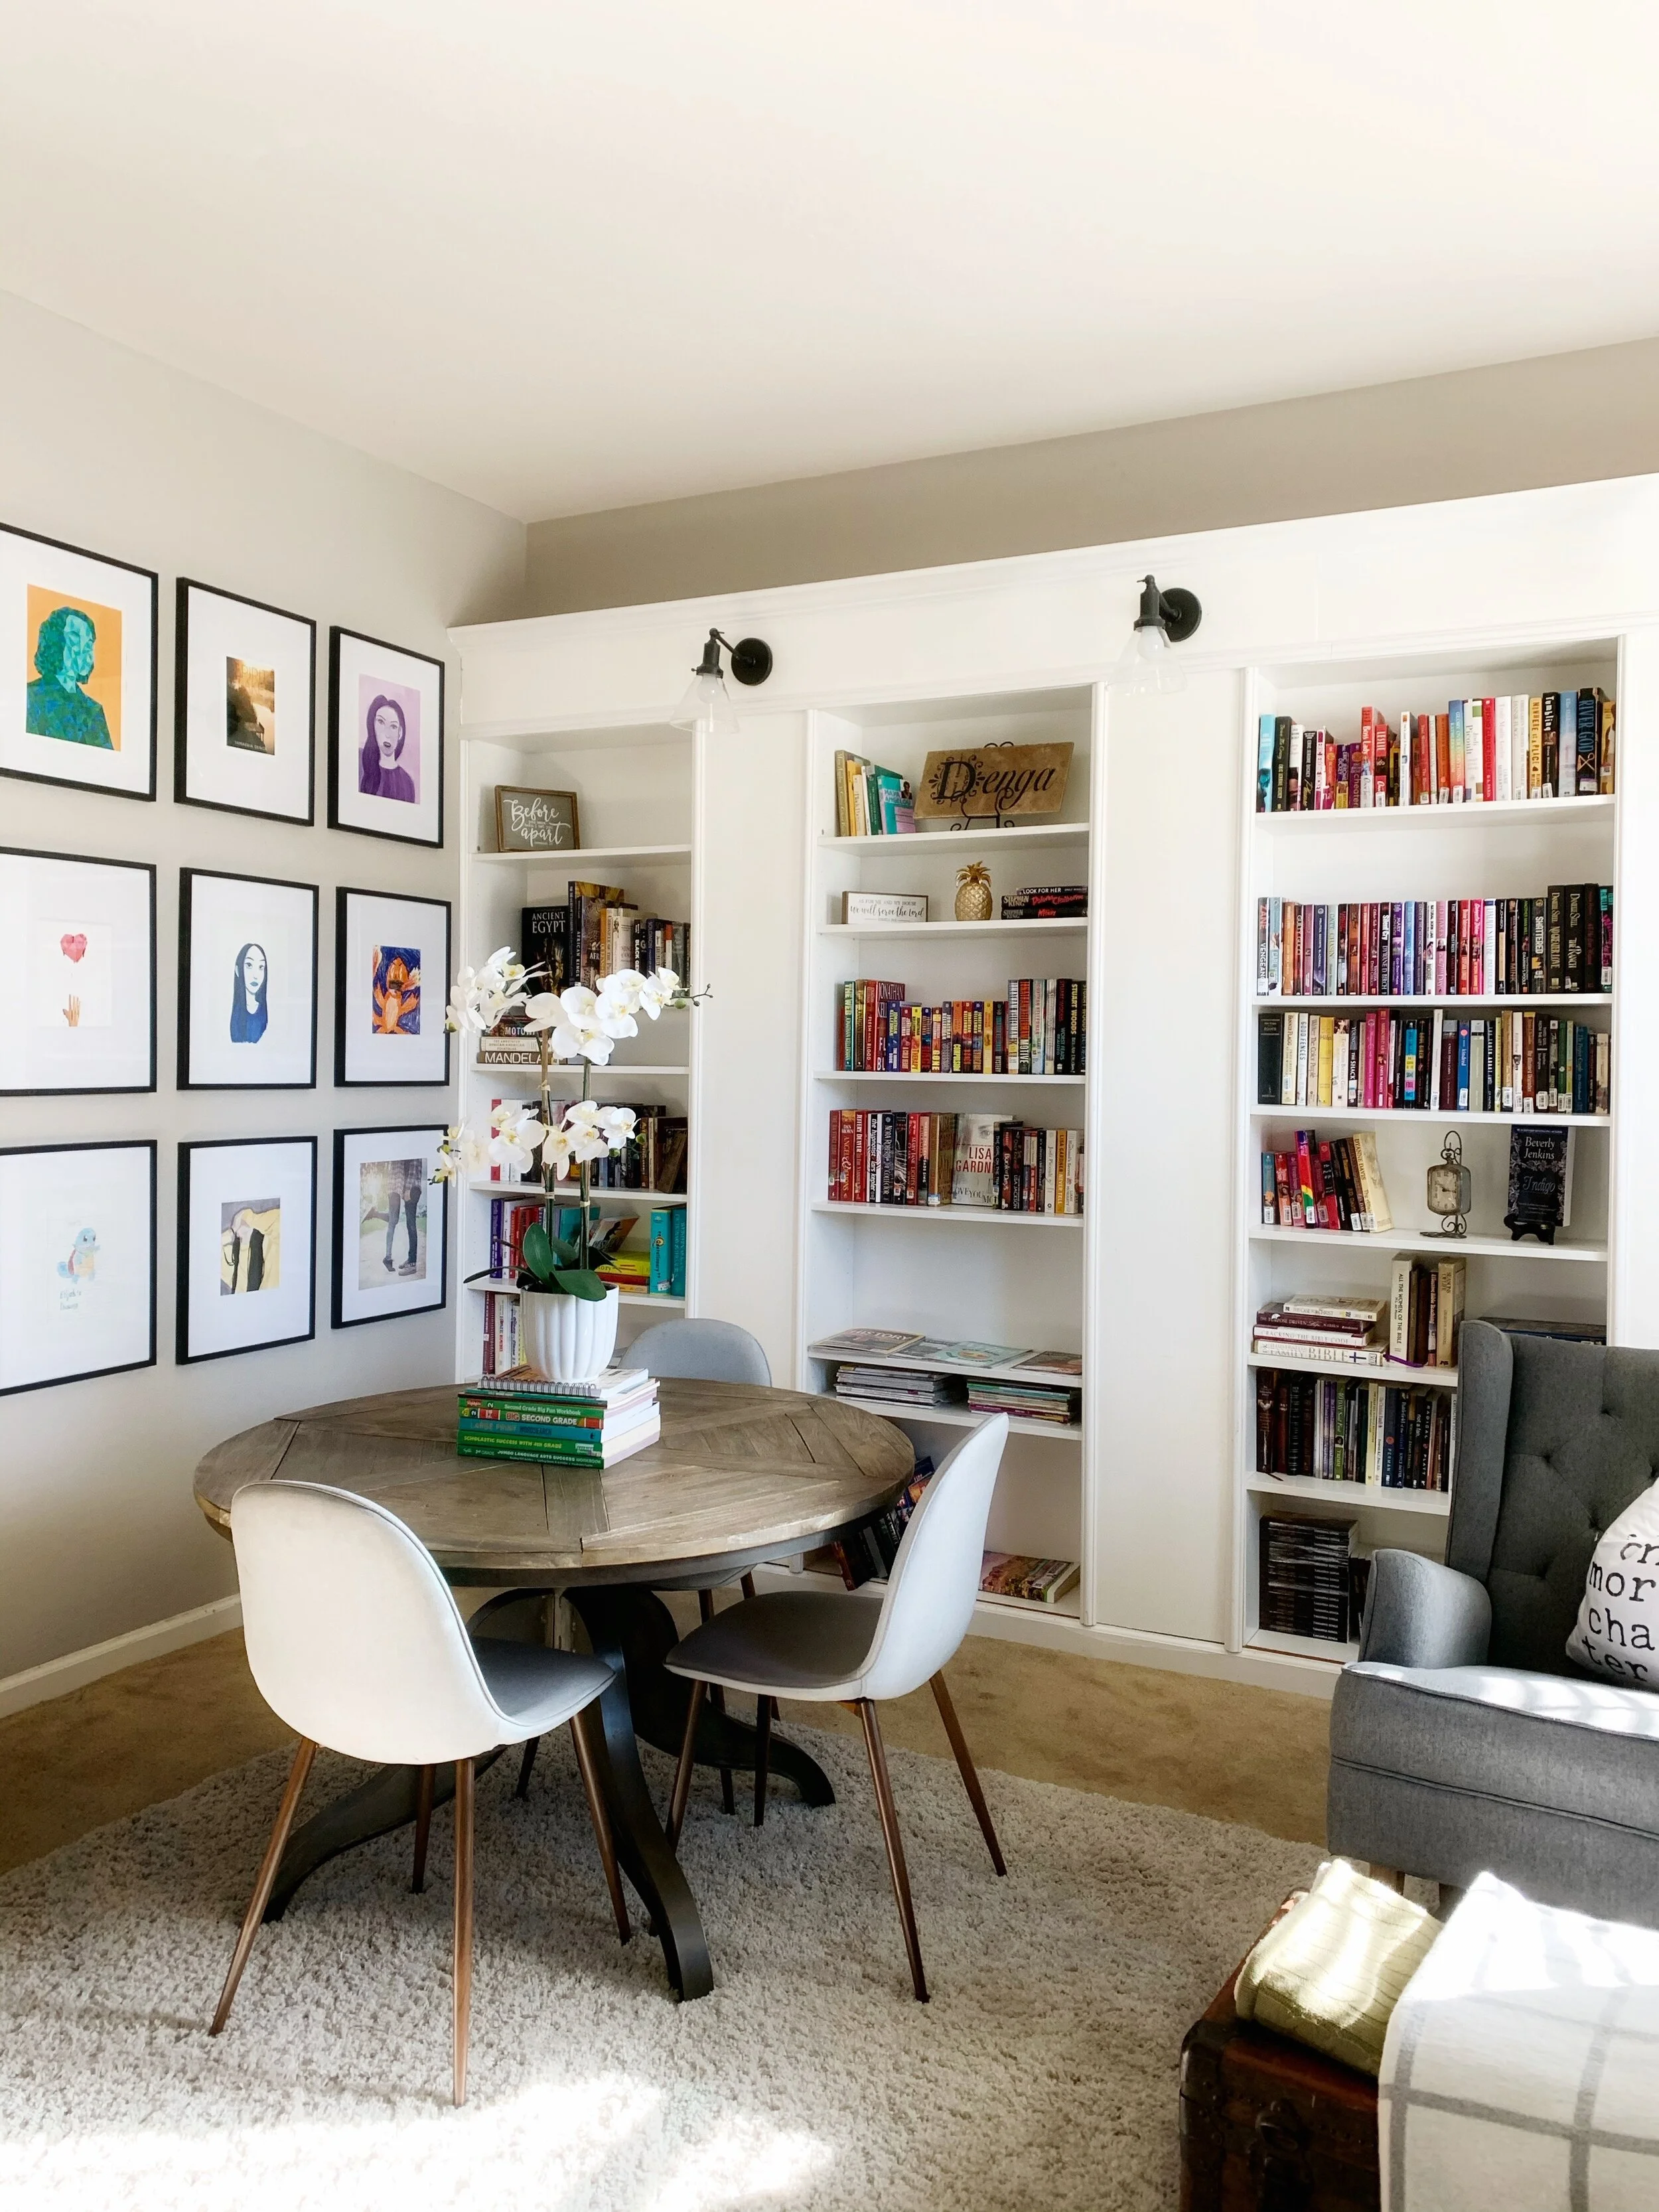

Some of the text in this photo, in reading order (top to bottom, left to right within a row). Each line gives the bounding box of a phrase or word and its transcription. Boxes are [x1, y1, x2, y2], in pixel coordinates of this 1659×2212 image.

[1544, 696, 1555, 731] Tumbling
[1579, 700, 1594, 753] RIVER GOD
[1362, 741, 1371, 755] Lady
[503, 797, 559, 831] Before
[521, 821, 571, 847] apart
[1004, 895, 1029, 905] STEPHEN
[1551, 892, 1560, 911] DANIELLE
[532, 911, 565, 921] ANCIENT
[1551, 910, 1560, 924] STEEL
[532, 921, 565, 933] EGYPT
[1535, 916, 1544, 954] SHATTERED
[1568, 893, 1582, 968] DANIELLE STEEL THE RANCH
[1551, 934, 1560, 953] GREATER
[1551, 954, 1560, 969] LOVE
[878, 983, 904, 1001] JONATHAN
[1020, 1039, 1029, 1063] MOTIVE
[1354, 1139, 1363, 1163] DYANNE
[1525, 1136, 1555, 1150] Beverly
[969, 1147, 992, 1159] LISA
[1524, 1148, 1555, 1159] Jenkins
[1522, 1175, 1555, 1195] Indigo
[851, 1329, 909, 1341] HISTORY
[1262, 1330, 1295, 1339] CRACKING
[1308, 1347, 1348, 1362] BIBLE
[506, 1412, 520, 1421] BIG
[522, 1414, 551, 1423] SECOND
[1589, 1607, 1656, 1651] cha
[1582, 1635, 1648, 1682] ter
